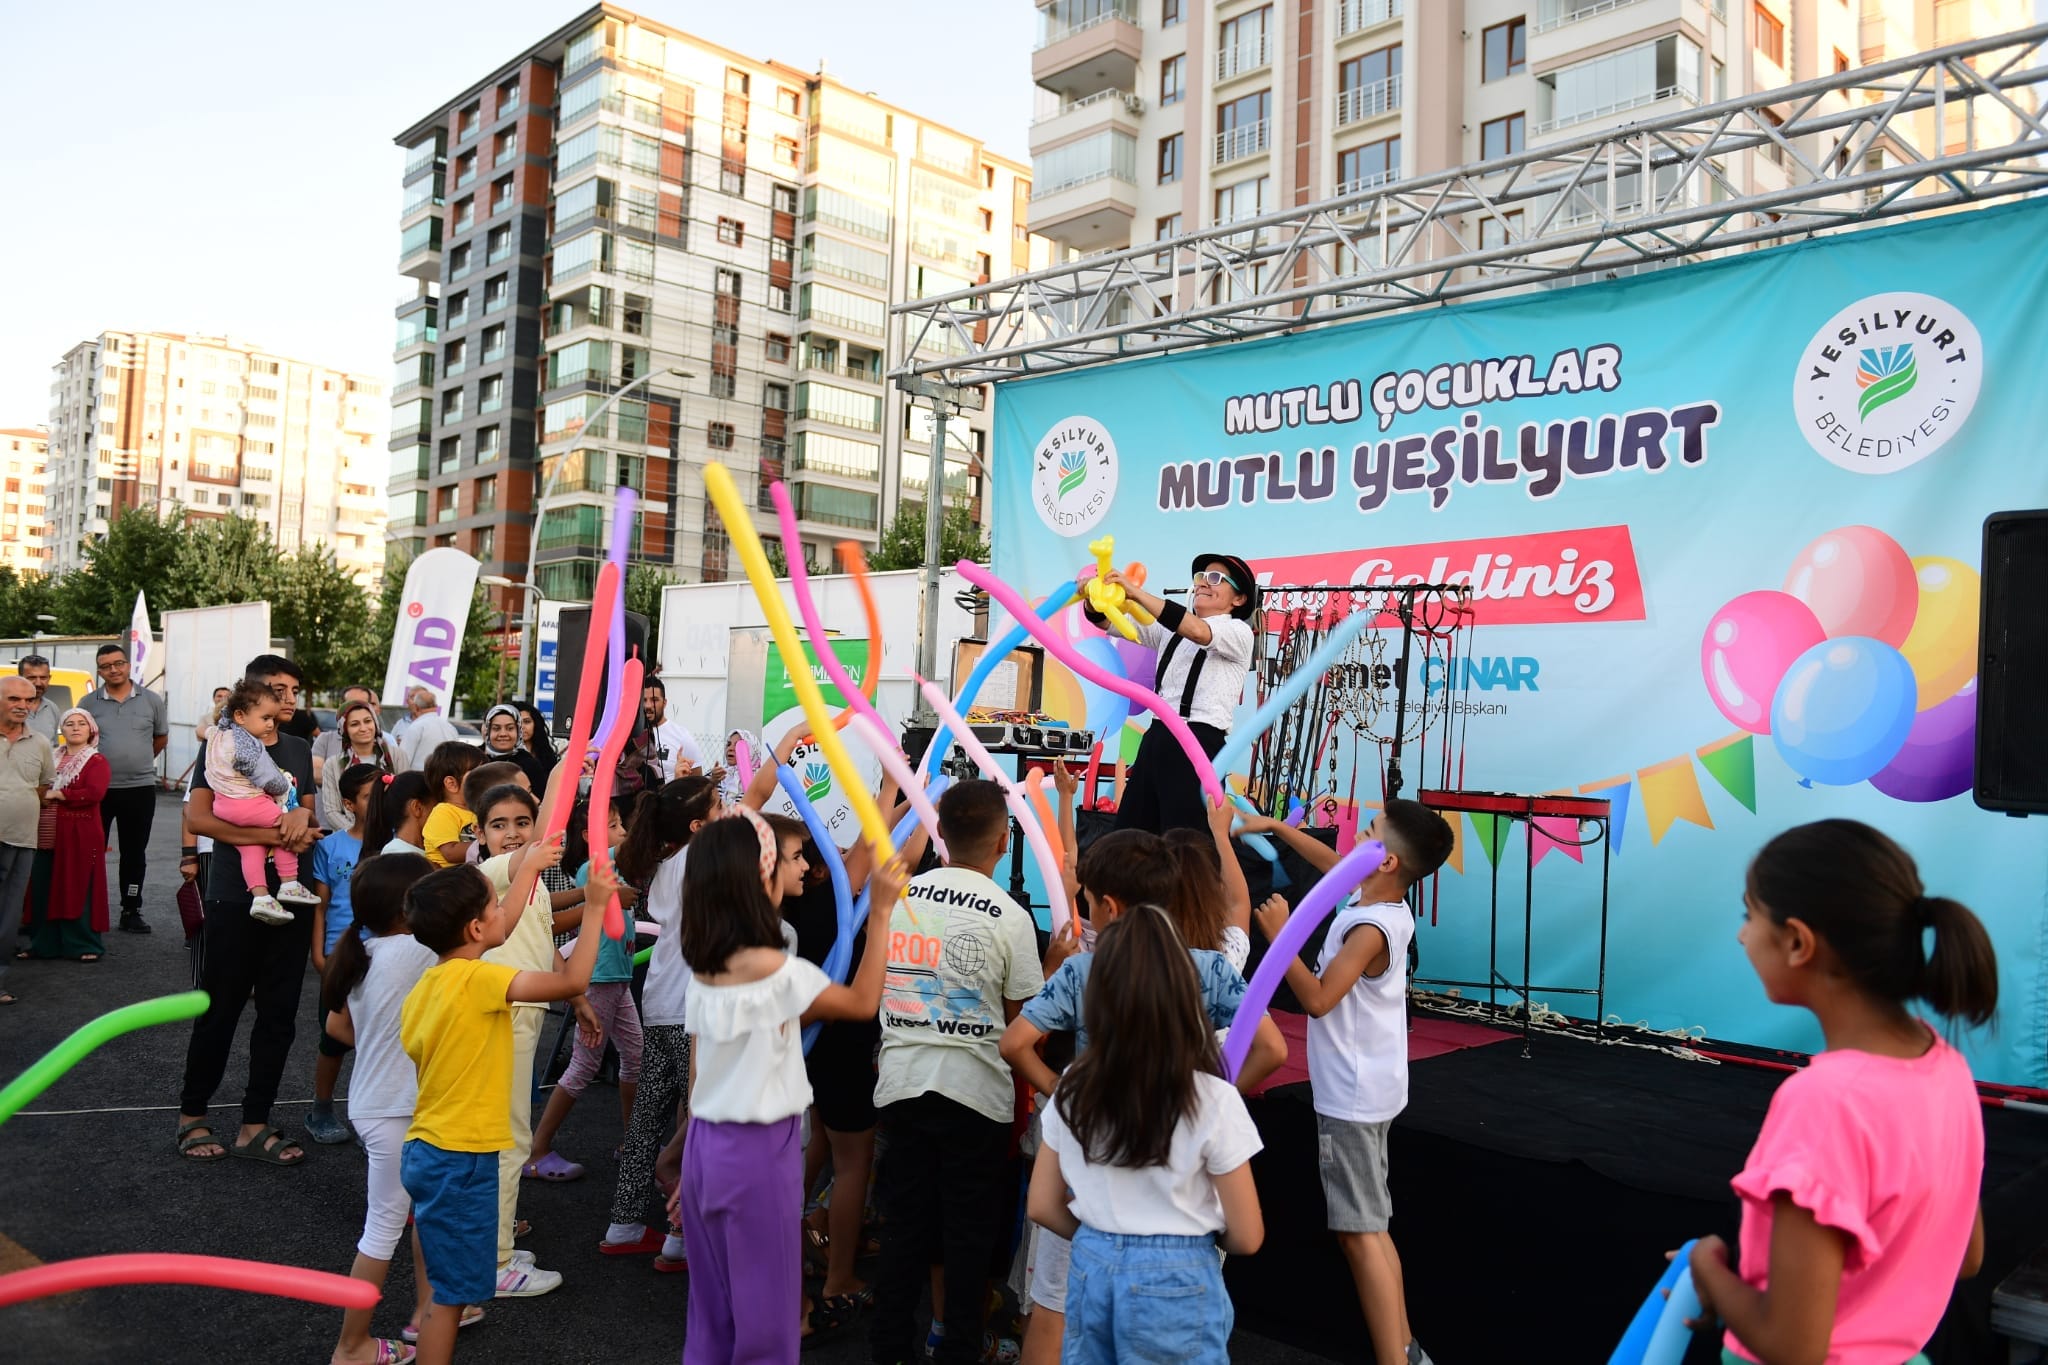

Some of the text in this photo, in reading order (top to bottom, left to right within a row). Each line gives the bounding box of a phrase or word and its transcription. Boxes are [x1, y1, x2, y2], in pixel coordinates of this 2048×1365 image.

[1225, 343, 1623, 434] MUTLU ÇOCUKLAR
[1157, 445, 1338, 512] MUTLU
[1349, 548, 1615, 614] Geldiniz
[1419, 656, 1540, 698] ÇINAR
[1454, 700, 1507, 717] Başkanı
[936, 1019, 994, 1037] Wear
